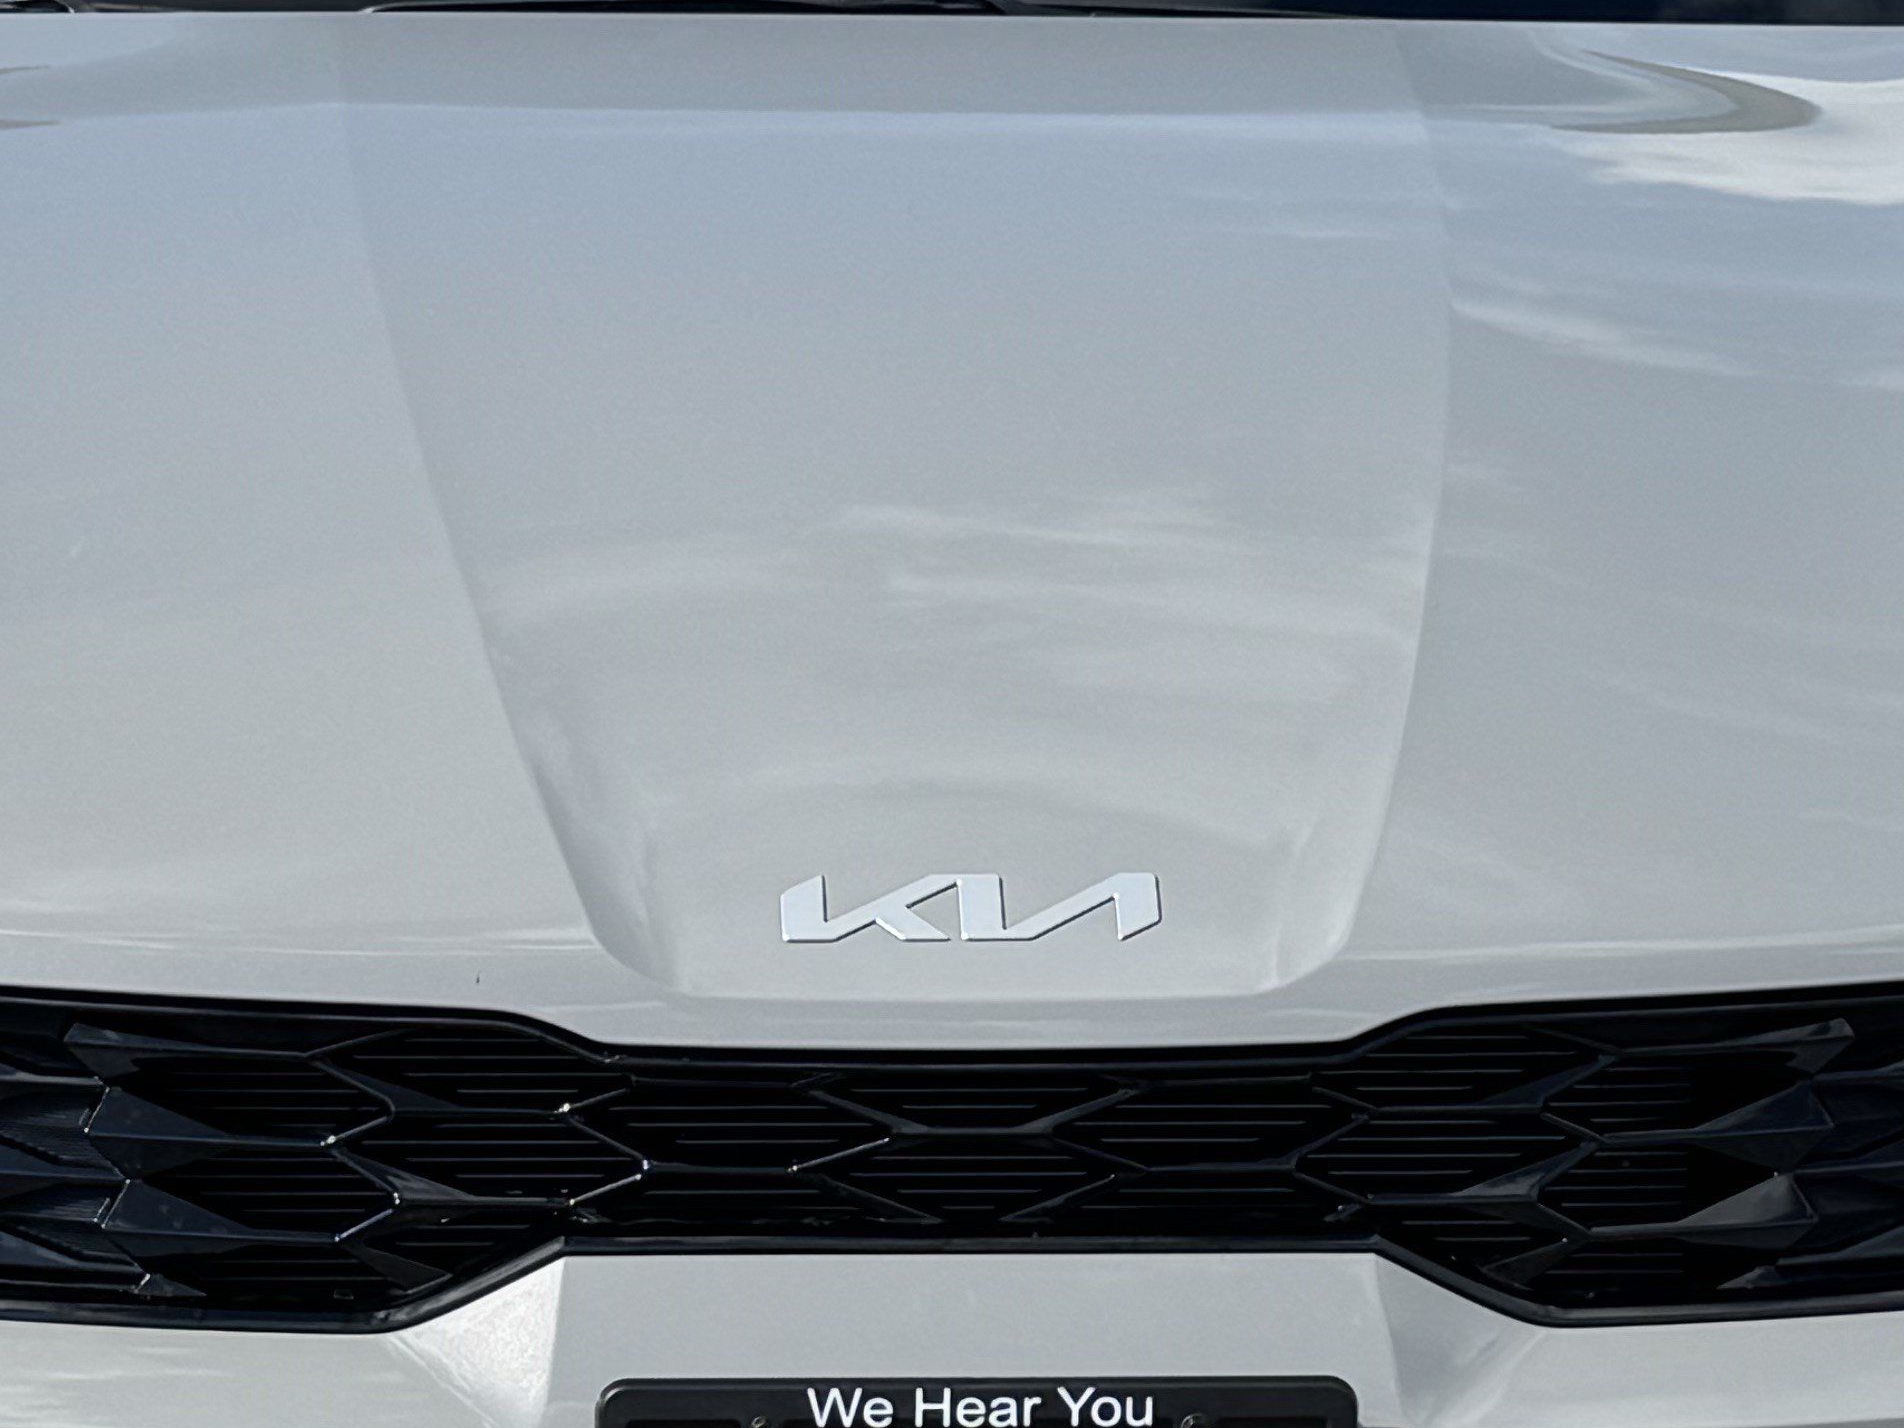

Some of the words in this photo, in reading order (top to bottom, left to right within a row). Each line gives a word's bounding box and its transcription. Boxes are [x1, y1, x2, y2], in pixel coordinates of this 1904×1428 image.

[780, 872, 1162, 943] KIA
[806, 1387, 894, 1428] We
[914, 1387, 1042, 1428] Hear
[1057, 1386, 1154, 1428] You
